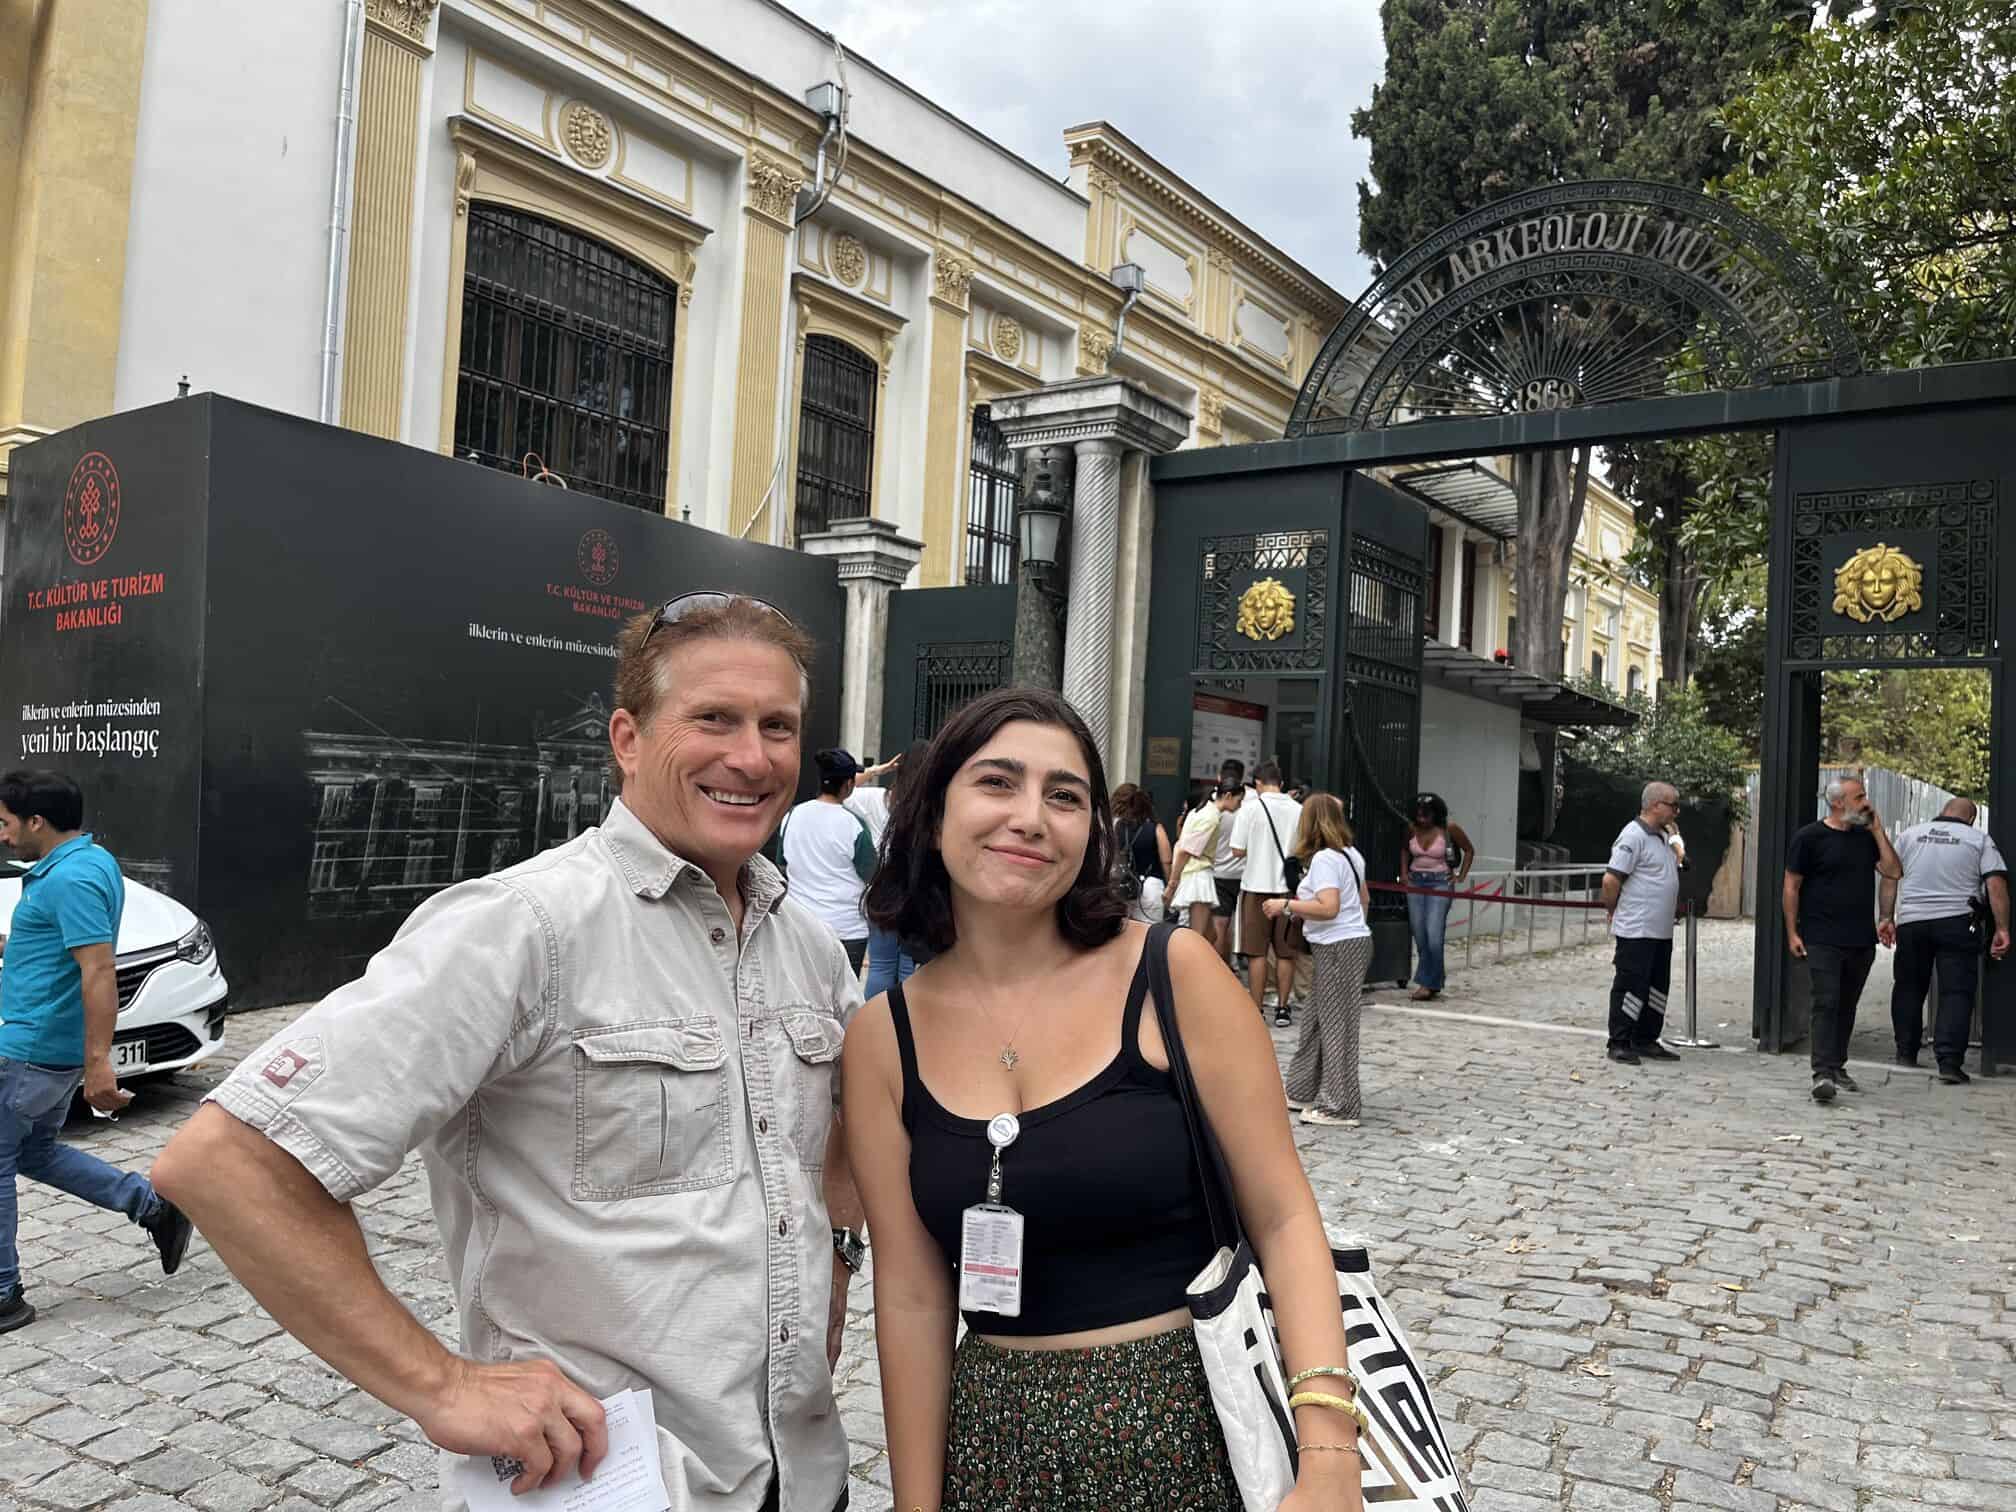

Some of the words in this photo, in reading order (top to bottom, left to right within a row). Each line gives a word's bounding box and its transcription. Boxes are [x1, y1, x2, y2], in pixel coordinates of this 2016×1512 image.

[1515, 379, 1575, 414] 1869
[28, 591, 45, 610] T.C.
[46, 580, 88, 608] KÜLTÜR
[91, 579, 109, 601] VE
[111, 571, 165, 599] TURİZM
[600, 593, 612, 606] VE
[56, 601, 122, 631] BAKANLIĞI
[469, 623, 509, 642] ilklerin
[510, 632, 524, 645] ve
[526, 633, 563, 651] enlerin
[565, 640, 619, 659] müzesinde
[22, 704, 49, 721] ilklerin
[50, 706, 60, 719] ve
[61, 701, 94, 719] enlerin
[96, 697, 161, 718] müzesinden
[21, 725, 49, 760] yeni
[52, 725, 73, 753] bir
[76, 722, 160, 758] başlangıç
[117, 1042, 146, 1066] 311
